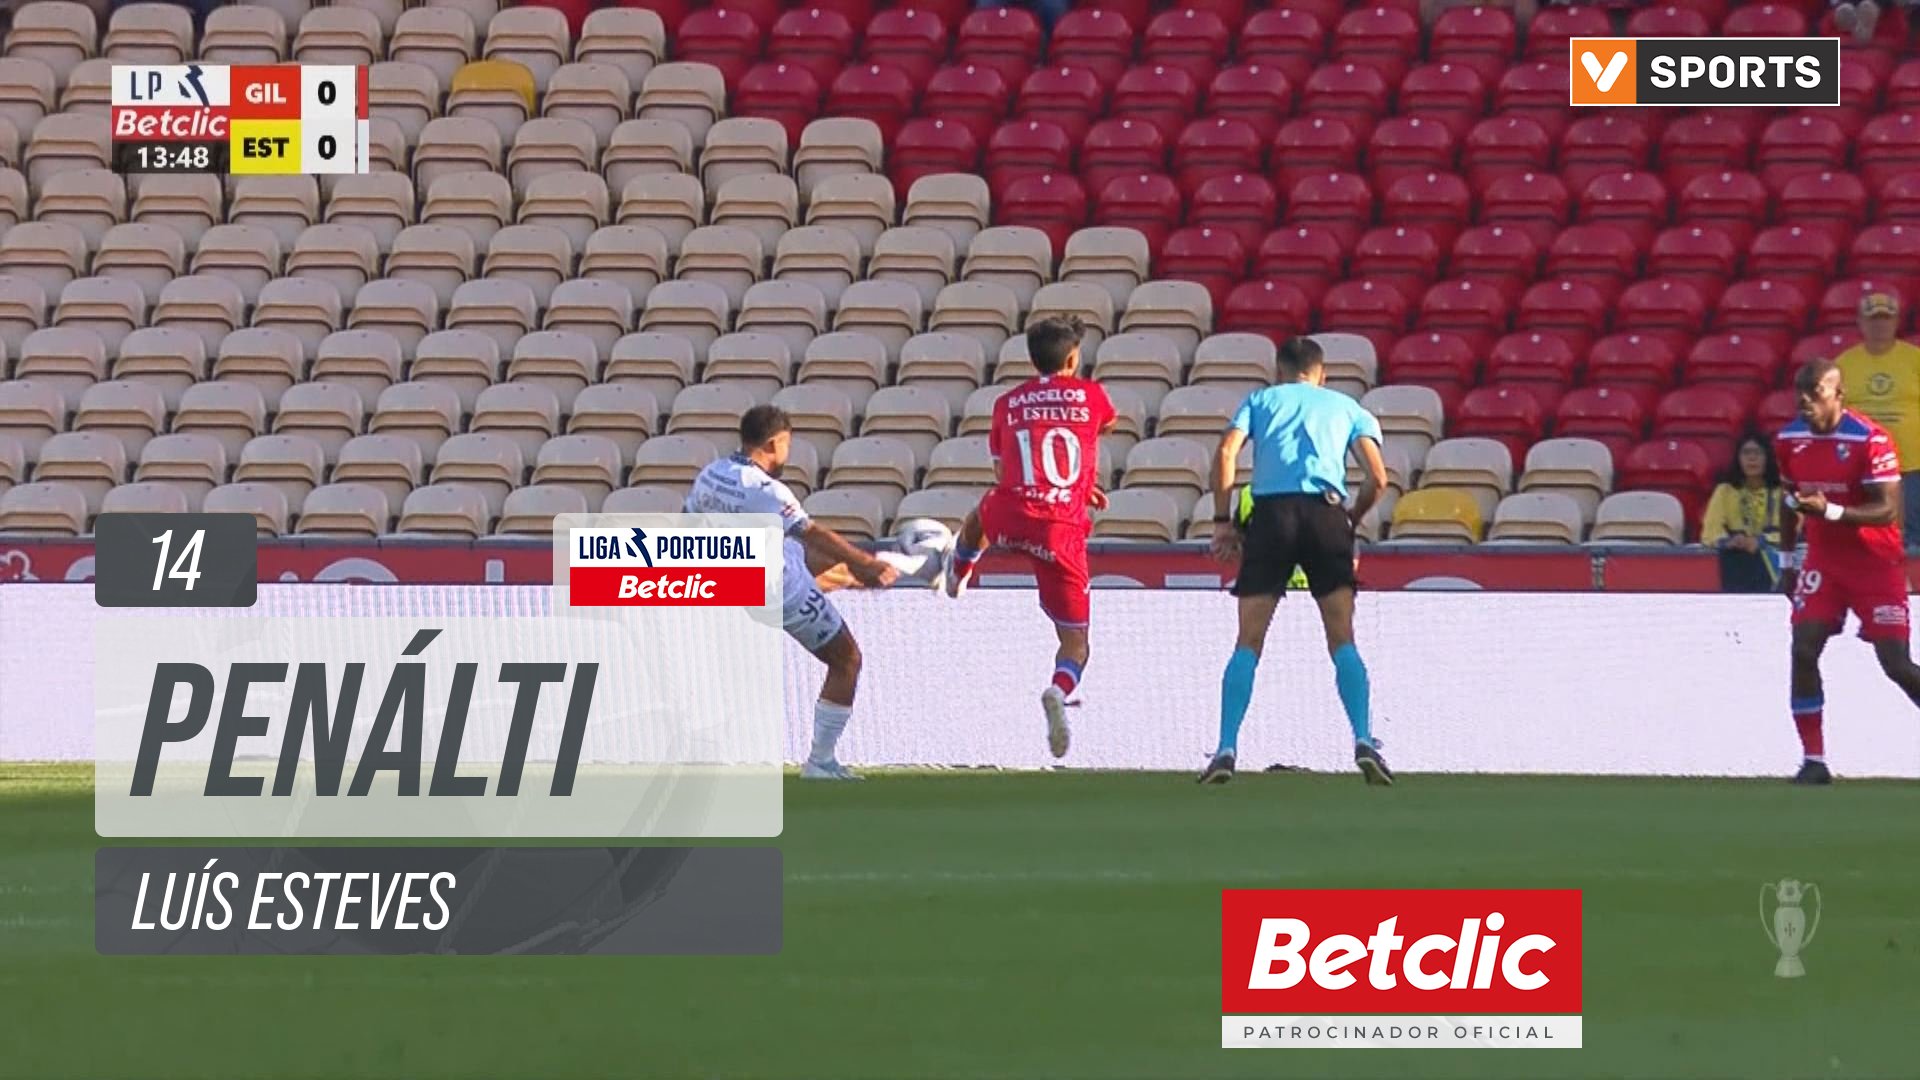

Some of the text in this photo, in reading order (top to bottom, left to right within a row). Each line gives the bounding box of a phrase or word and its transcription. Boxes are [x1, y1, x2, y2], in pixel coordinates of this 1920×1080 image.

[1008, 389, 1087, 408] BARCELOS
[1023, 407, 1090, 423] ESTEVES
[1015, 427, 1082, 488] 10
